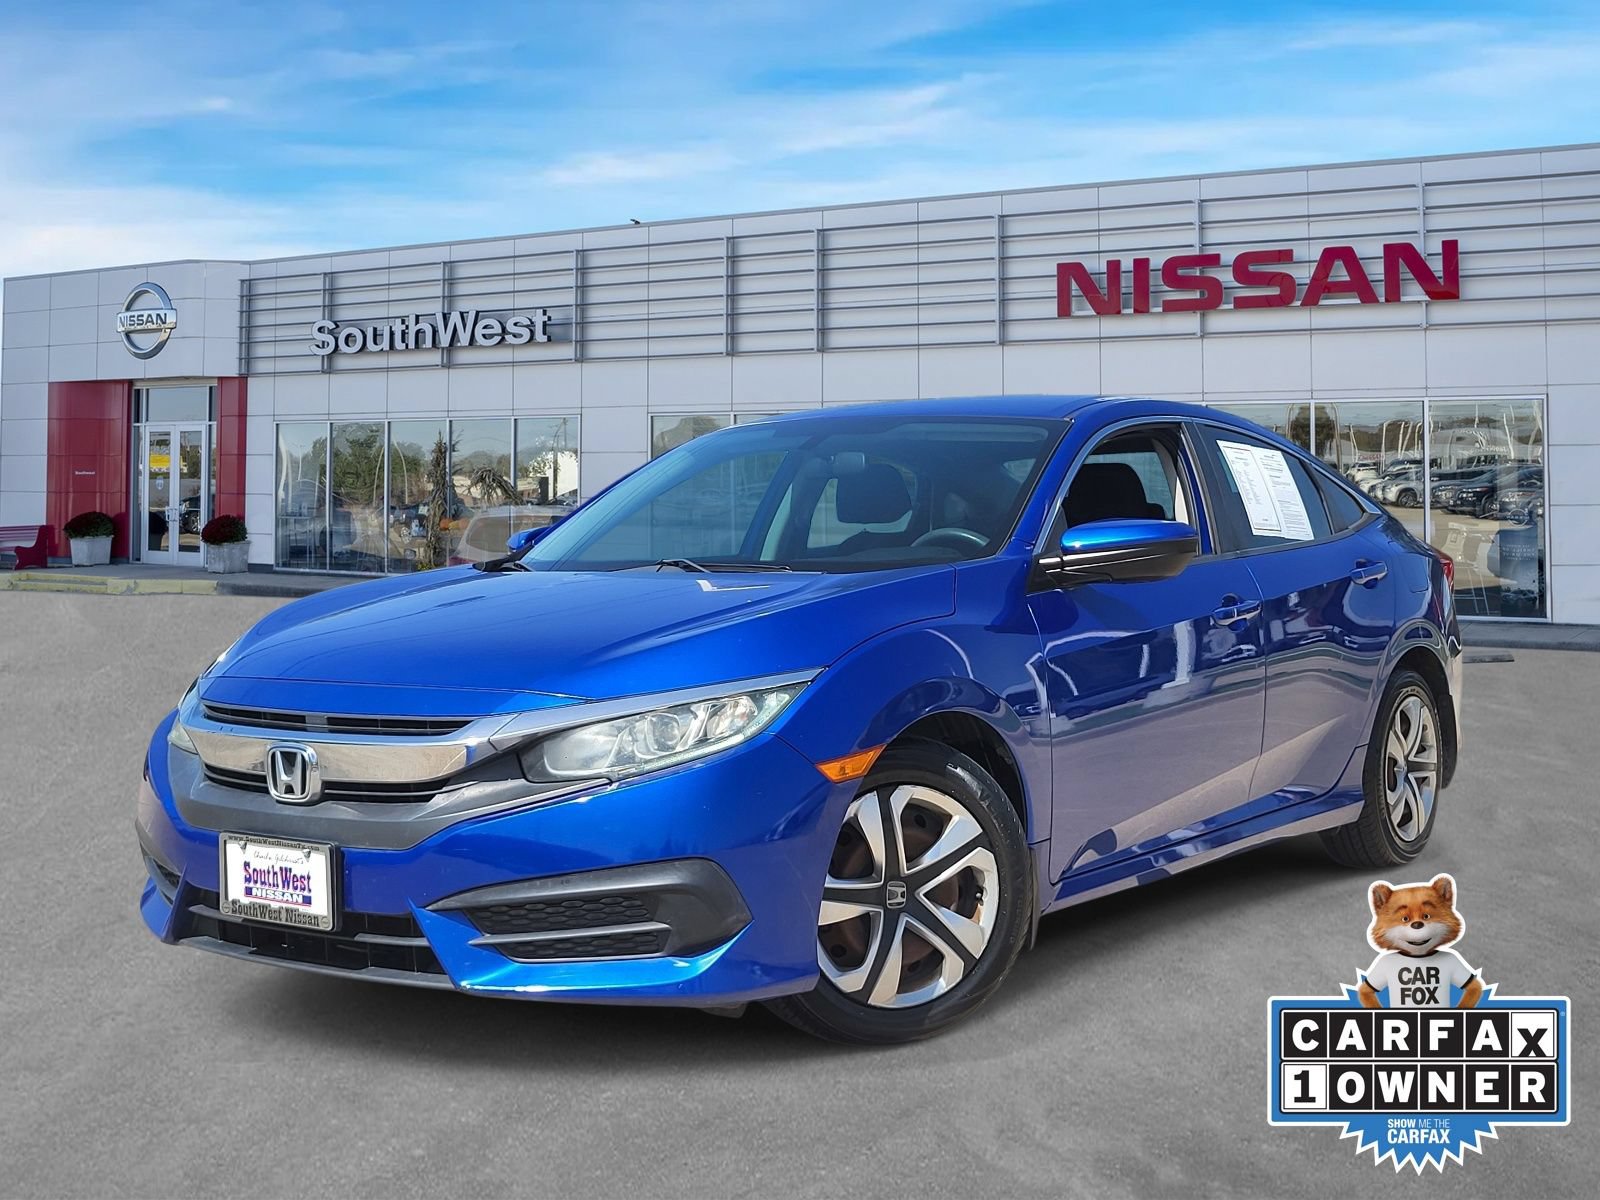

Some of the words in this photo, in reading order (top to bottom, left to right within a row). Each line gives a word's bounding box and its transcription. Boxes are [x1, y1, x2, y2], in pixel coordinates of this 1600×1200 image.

[1056, 239, 1460, 318] NISSAN
[119, 312, 167, 328] NISSAN
[309, 308, 552, 356] SouthWest
[243, 860, 312, 894] SouthWest
[252, 887, 303, 903] NISSAN
[231, 900, 283, 920] SouthWest
[285, 906, 320, 927] Nissan
